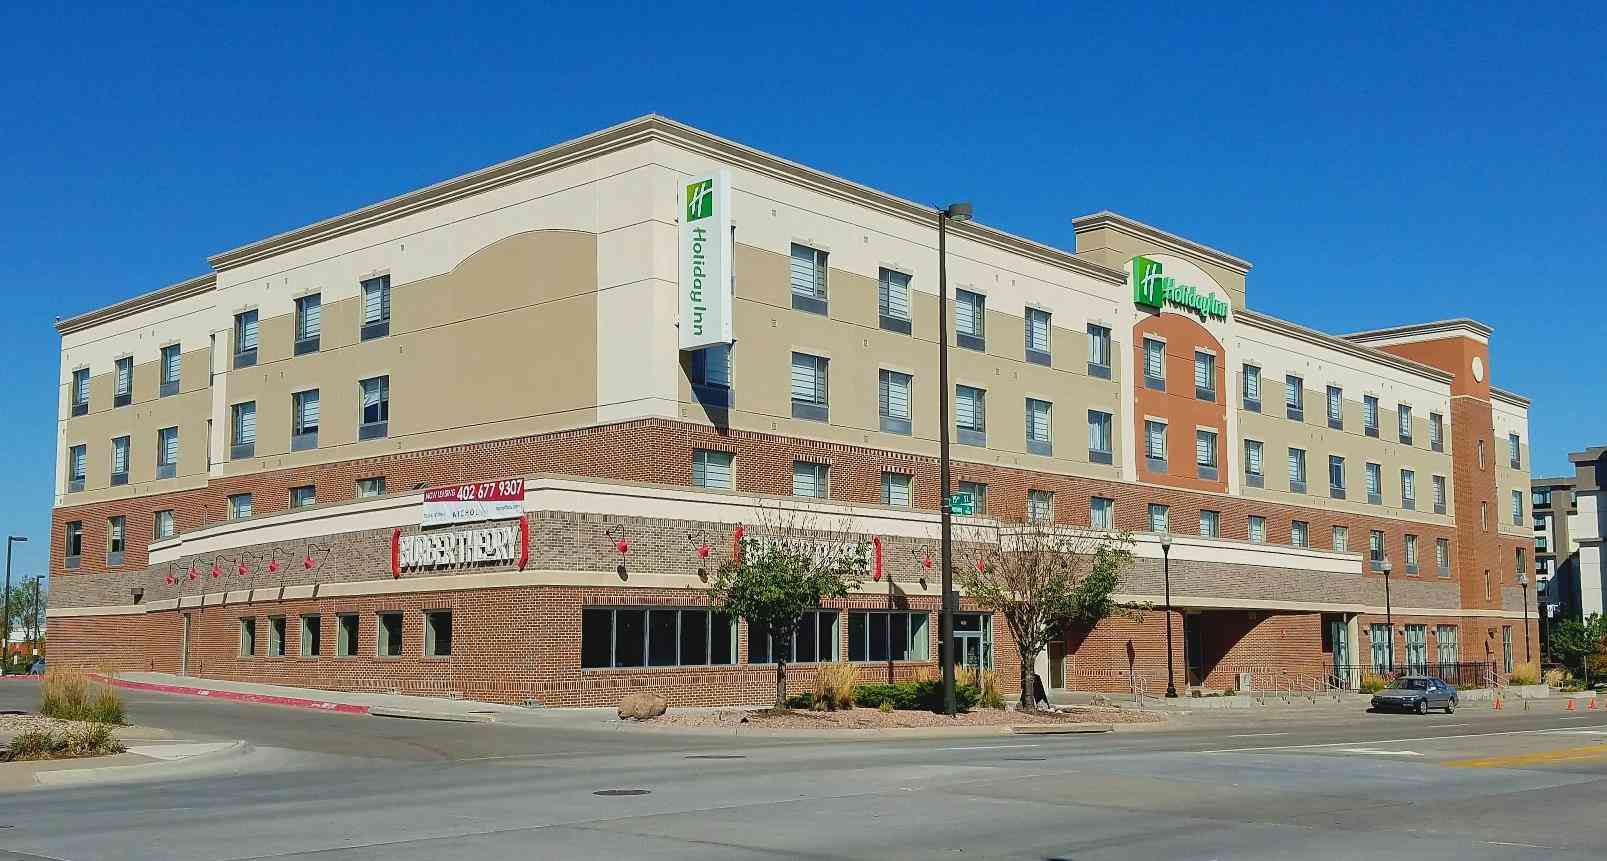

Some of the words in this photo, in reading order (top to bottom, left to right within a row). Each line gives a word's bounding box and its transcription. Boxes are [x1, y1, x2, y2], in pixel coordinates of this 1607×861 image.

[690, 226, 707, 303] Holiday
[1162, 276, 1209, 317] Holiday
[1208, 291, 1228, 318] Inn
[694, 306, 707, 336] Inn
[457, 485, 476, 501] 402
[477, 482, 496, 499] 677
[498, 479, 523, 497] 9307
[399, 532, 456, 568] BURGER
[456, 525, 519, 563] THEORY
